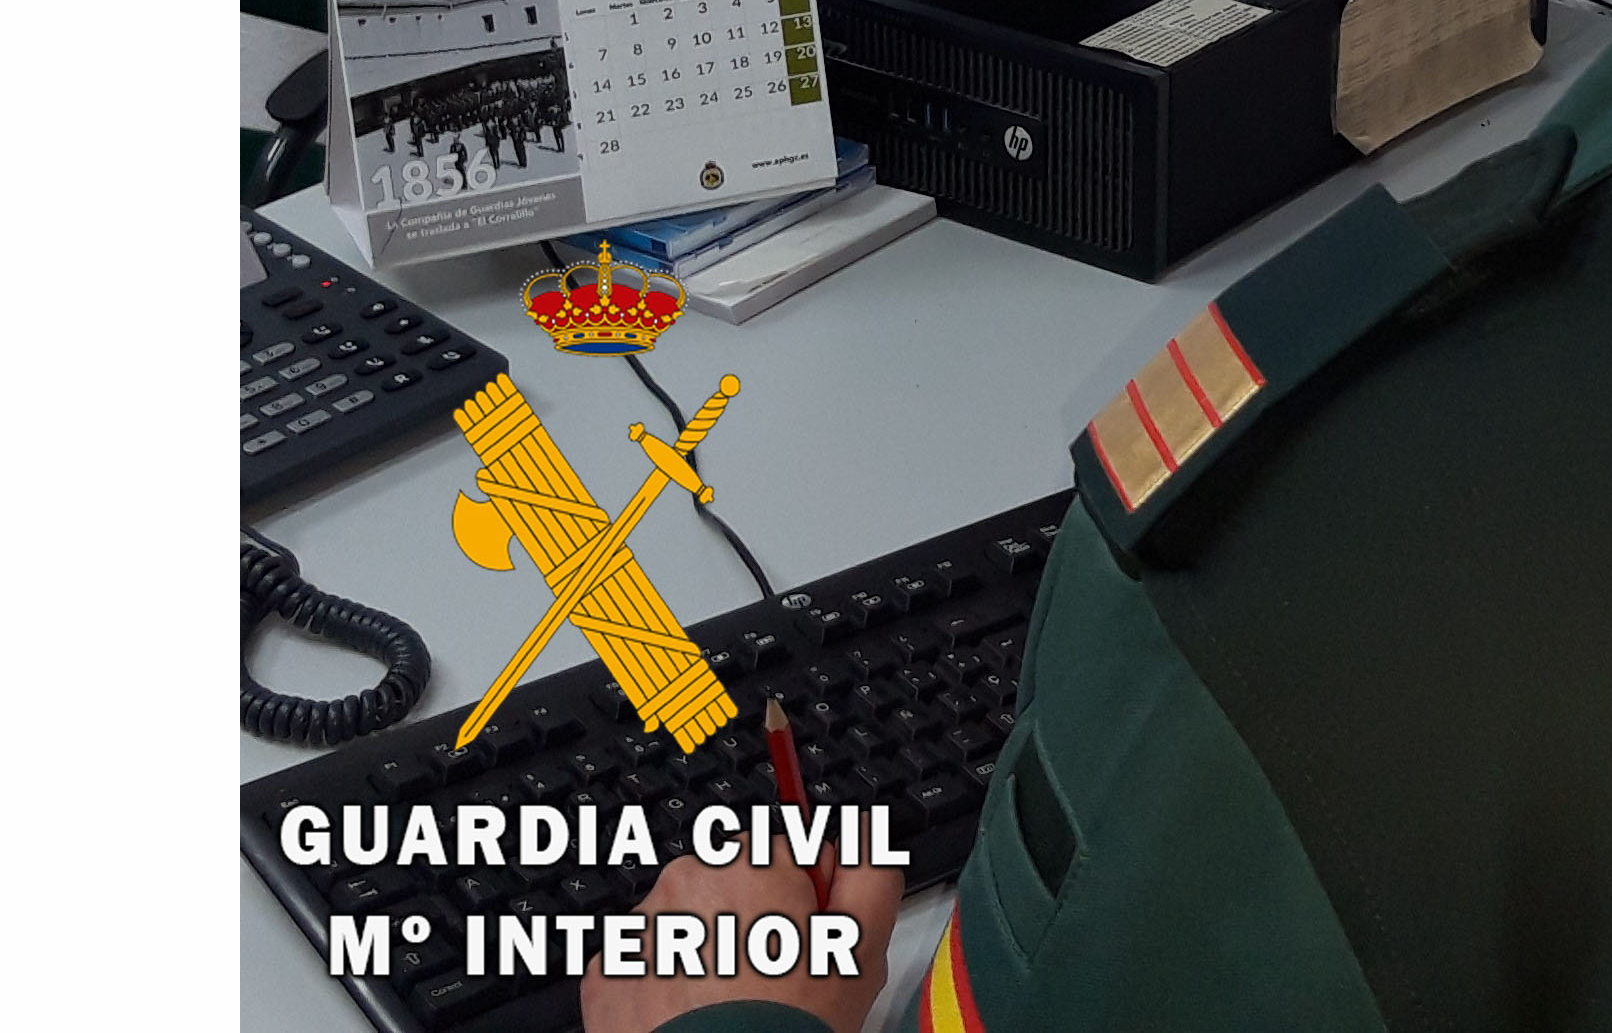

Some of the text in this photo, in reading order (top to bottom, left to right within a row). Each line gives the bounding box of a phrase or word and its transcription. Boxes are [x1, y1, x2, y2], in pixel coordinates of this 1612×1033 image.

[630, 14, 639, 25] 1
[664, 8, 673, 20] 2
[698, 2, 708, 14] 3
[598, 17, 812, 62] 7 8 9 10 11 12 13
[593, 45, 816, 93] 14 15 16 17 18 19 20
[596, 74, 819, 124] 21 22 23 24 25 26 27
[600, 140, 620, 154] 28
[1004, 126, 1033, 161] hp
[371, 148, 497, 210] 1856
[455, 208, 468, 218] de
[470, 199, 514, 214] Guardias
[406, 231, 417, 240] se
[464, 877, 480, 890] A
[569, 879, 586, 891] X
[517, 899, 534, 911] Z
